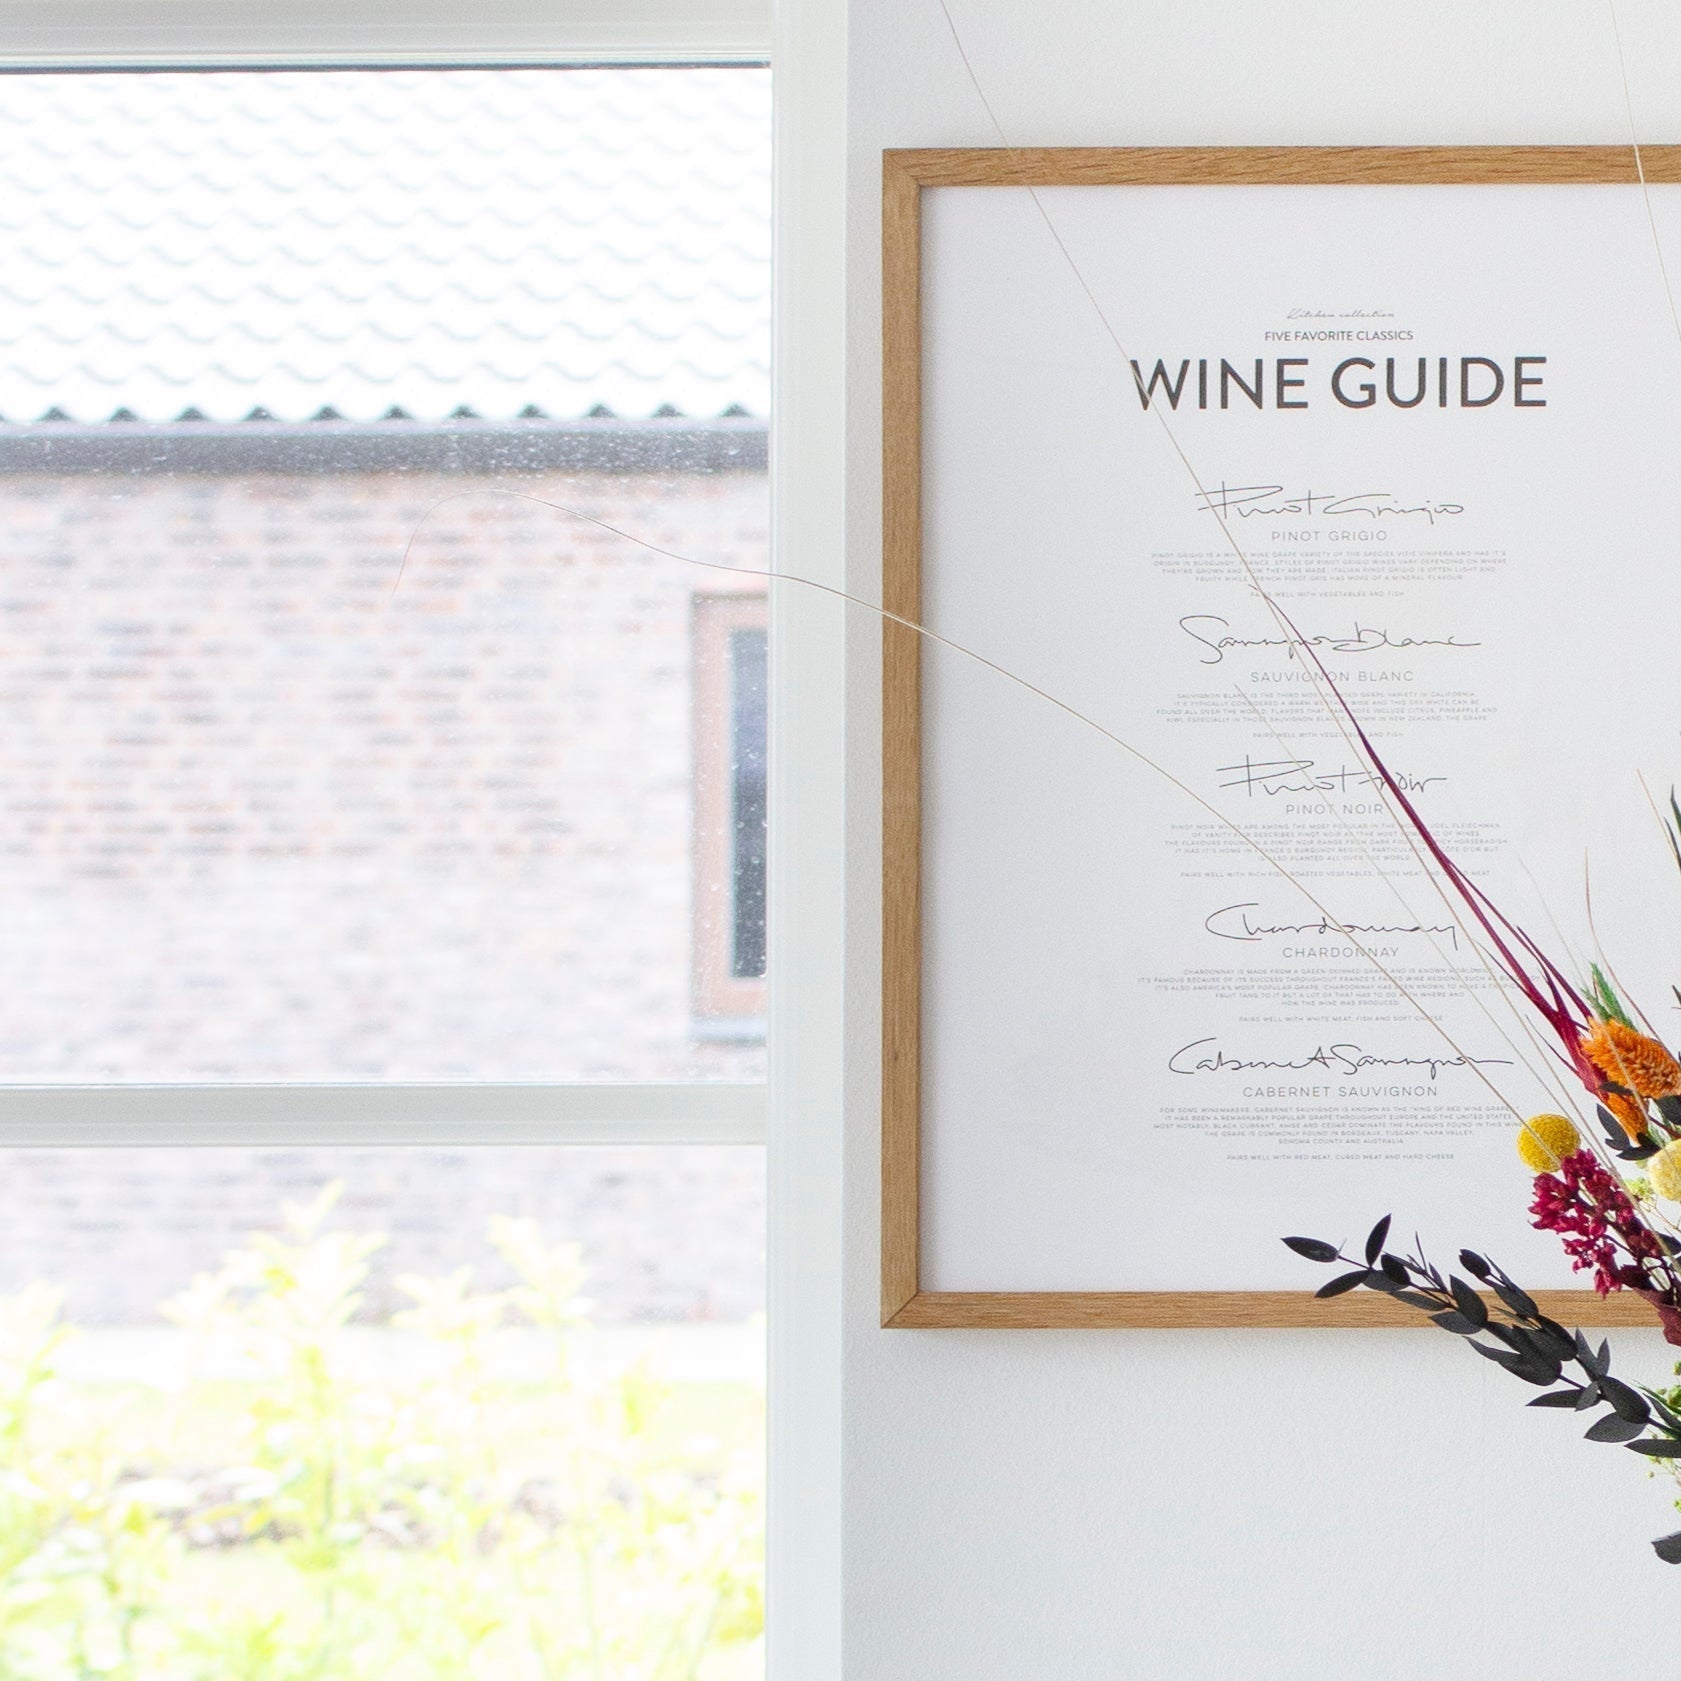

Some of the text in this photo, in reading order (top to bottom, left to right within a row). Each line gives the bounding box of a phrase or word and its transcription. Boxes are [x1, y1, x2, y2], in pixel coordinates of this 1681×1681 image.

[1339, 308, 1395, 319] collection
[1265, 330, 1413, 341] FIVE FAVORITE CLASSICS
[1130, 356, 1548, 410] WINE GUIDE
[1272, 531, 1387, 541] PINOT GRIGIO
[1251, 670, 1413, 683] SAUVIGNON BLANC
[1286, 804, 1384, 815] PINOT NOIR
[1205, 903, 1458, 950] Chardonnay
[1283, 947, 1399, 958] CHARDONNAY
[1243, 1085, 1437, 1097] CABERNET SAUVIGNON
